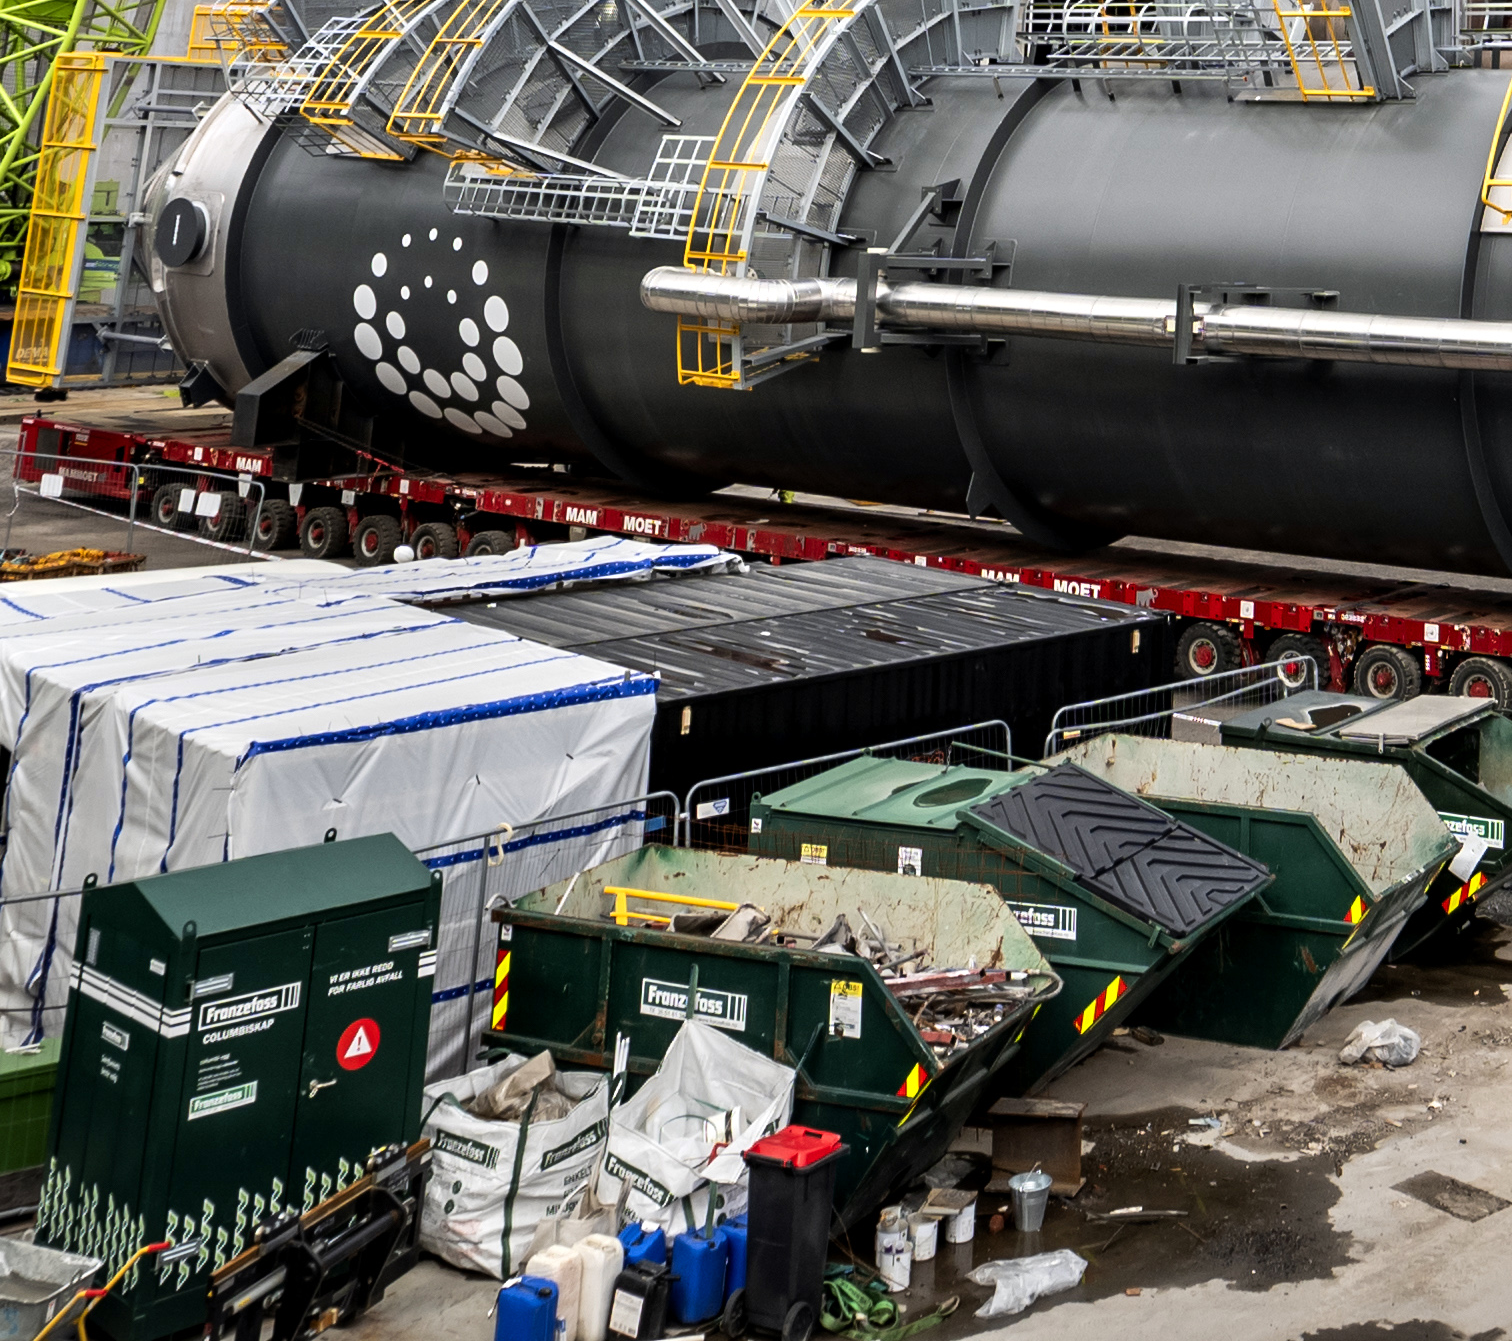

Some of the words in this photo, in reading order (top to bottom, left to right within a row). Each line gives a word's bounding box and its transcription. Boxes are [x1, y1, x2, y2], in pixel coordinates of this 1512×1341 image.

[236, 456, 262, 473] MAM
[565, 506, 598, 526] MAM
[623, 515, 662, 535] MOET
[981, 568, 1020, 584] MAM
[1053, 578, 1101, 600] MOET
[327, 984, 345, 997] FOR
[648, 984, 724, 1015] Franzfoss
[205, 993, 278, 1024] Franzefoss
[202, 1018, 276, 1045] COLUMBISKAP
[193, 1089, 244, 1112] Franzefoss
